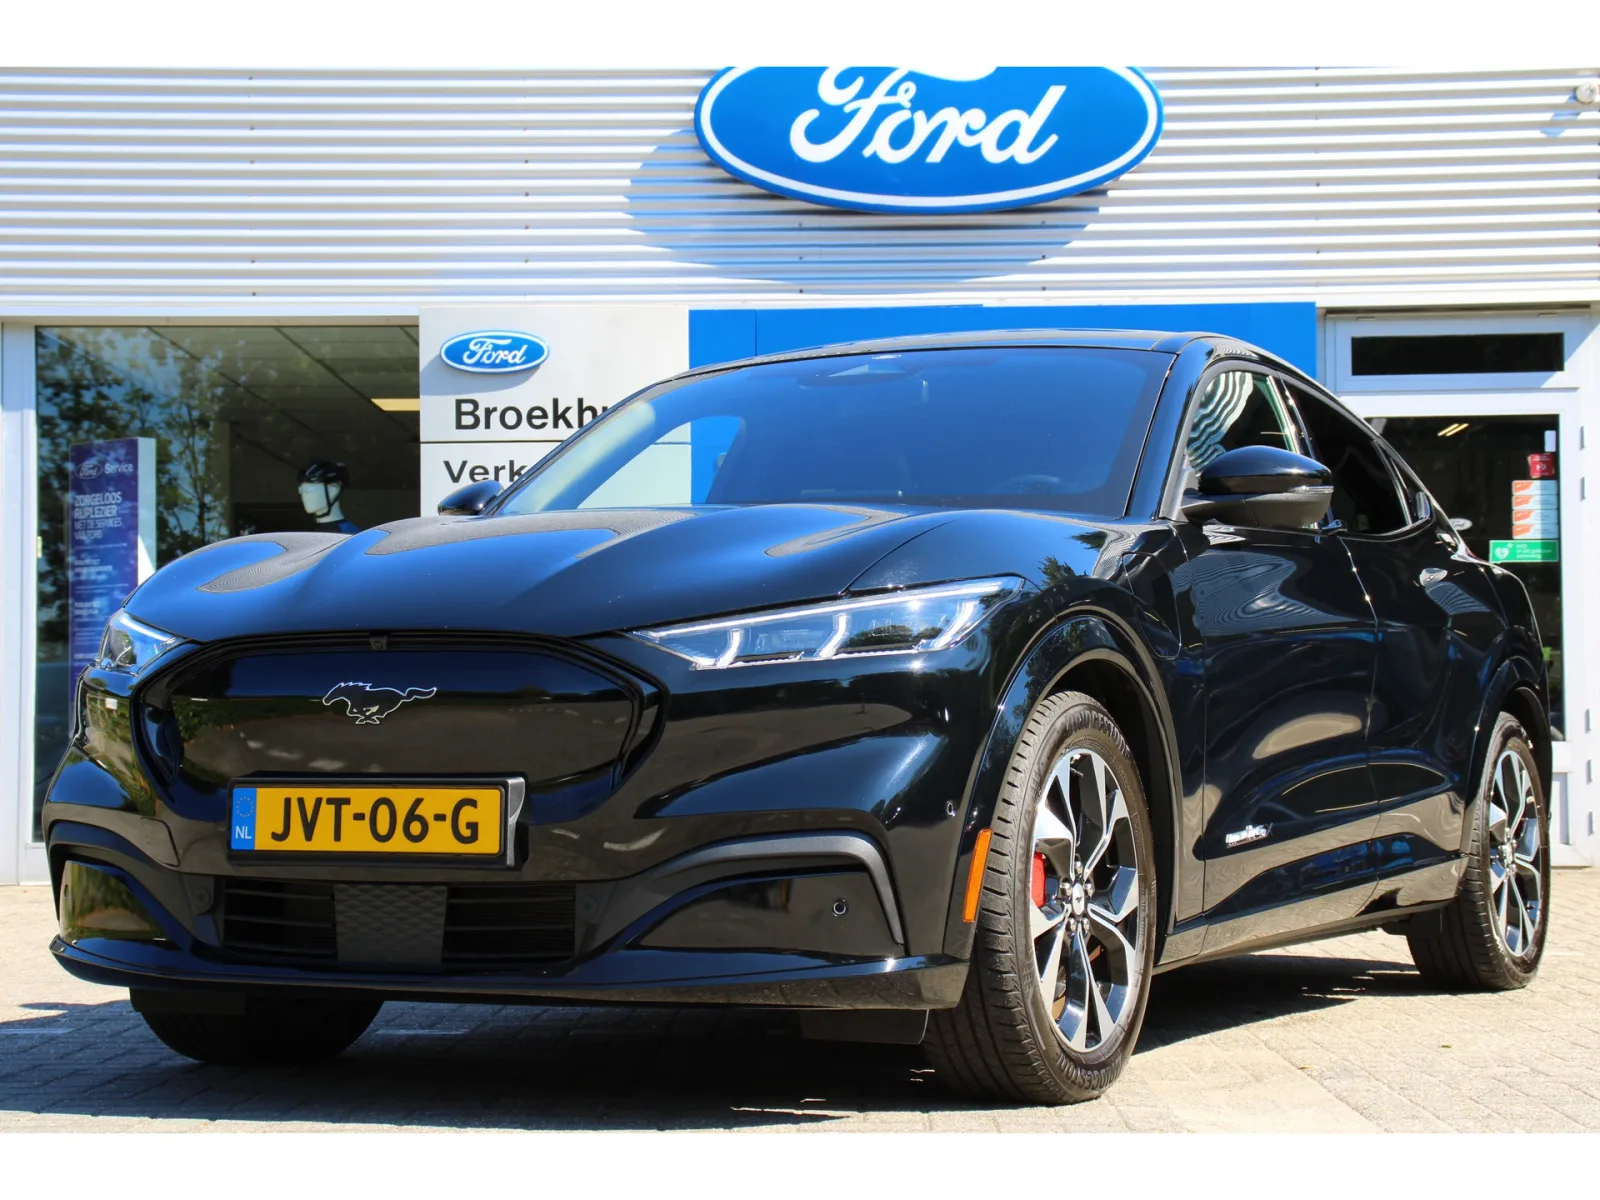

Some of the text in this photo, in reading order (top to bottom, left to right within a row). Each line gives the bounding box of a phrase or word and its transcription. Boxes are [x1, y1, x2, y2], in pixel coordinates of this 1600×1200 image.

[790, 67, 1067, 164] Ford
[462, 338, 527, 364] Ford
[454, 398, 609, 430] Broekh
[104, 463, 134, 475] Service
[74, 492, 122, 507] ZORGELOOS
[235, 825, 252, 840] NL
[270, 797, 479, 844] JVT-06-G
